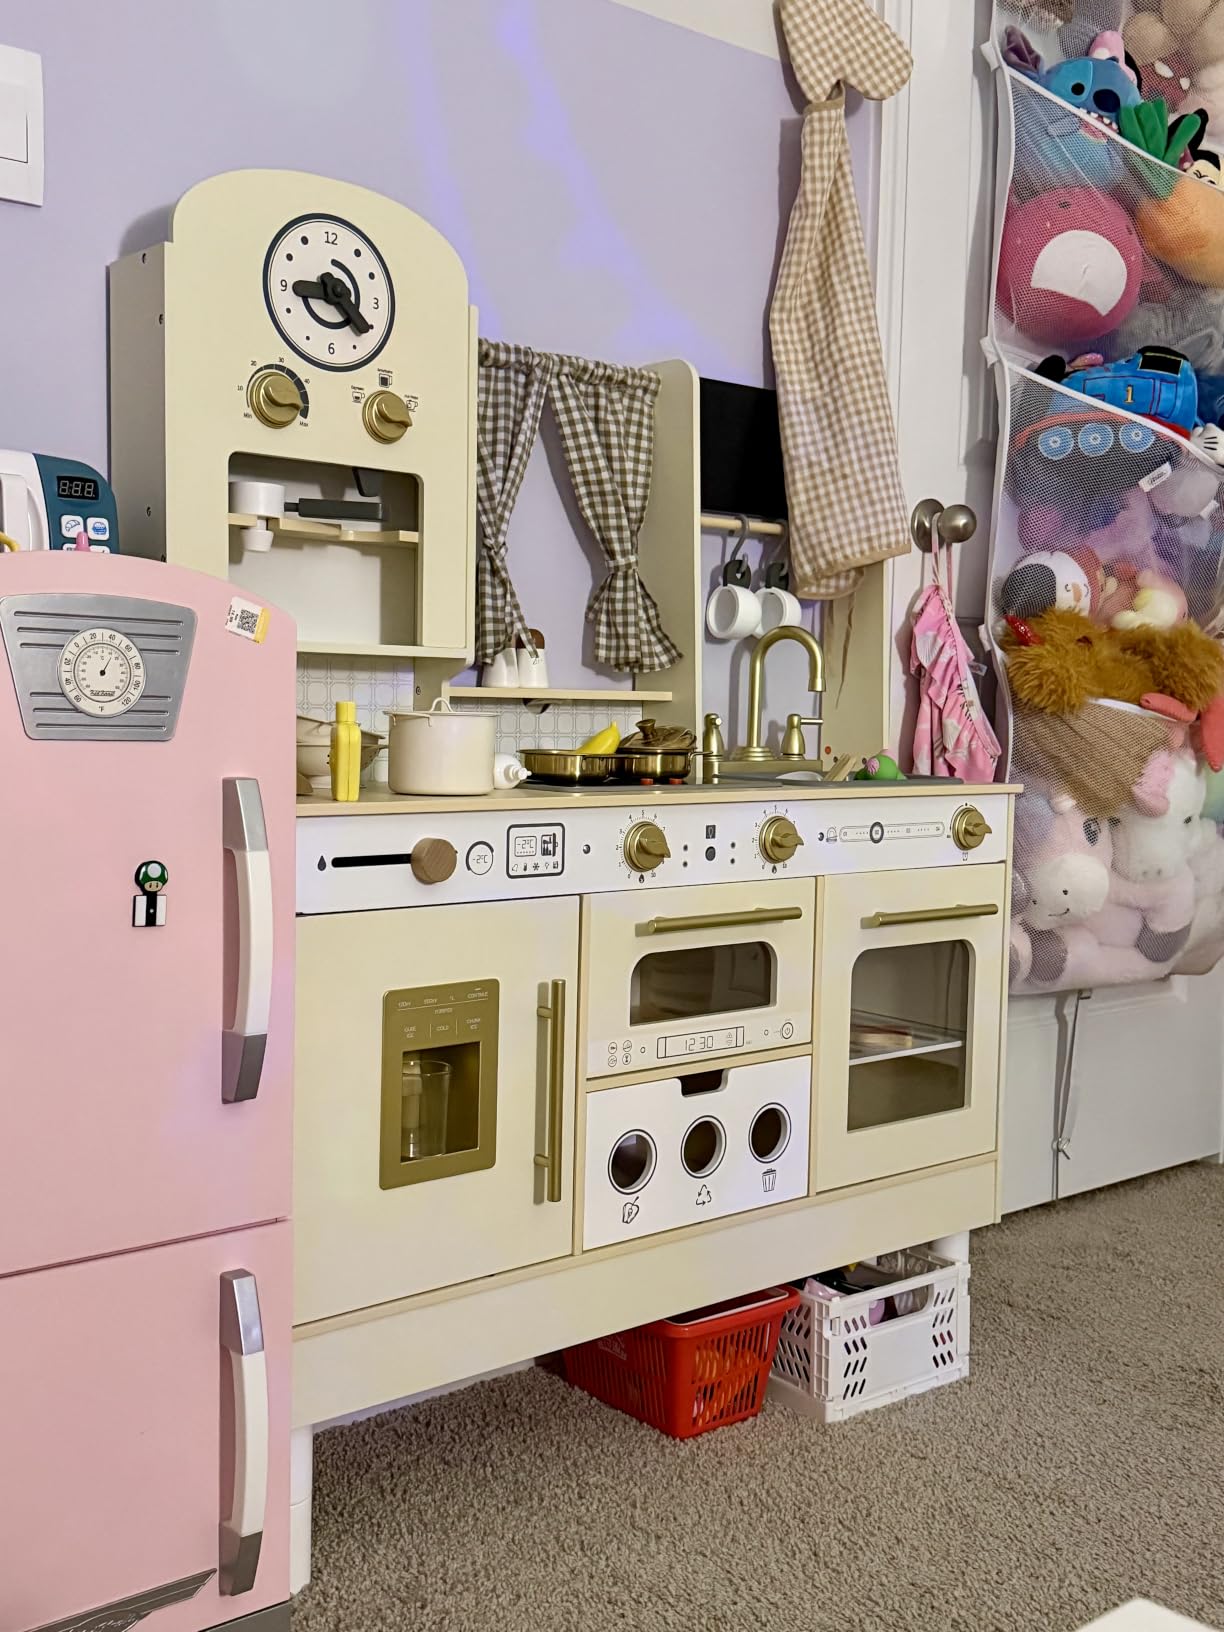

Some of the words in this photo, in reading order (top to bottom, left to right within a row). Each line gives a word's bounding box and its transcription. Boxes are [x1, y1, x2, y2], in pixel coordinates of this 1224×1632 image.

[324, 231, 339, 246] 12
[279, 279, 288, 292] 9
[372, 297, 380, 310] 3
[327, 343, 336, 356] 6
[1124, 384, 1135, 403] 1
[89, 632, 97, 640] 20
[125, 644, 133, 653] 60
[65, 678, 72, 686] 40
[133, 681, 141, 691] 100
[122, 697, 131, 706] 120
